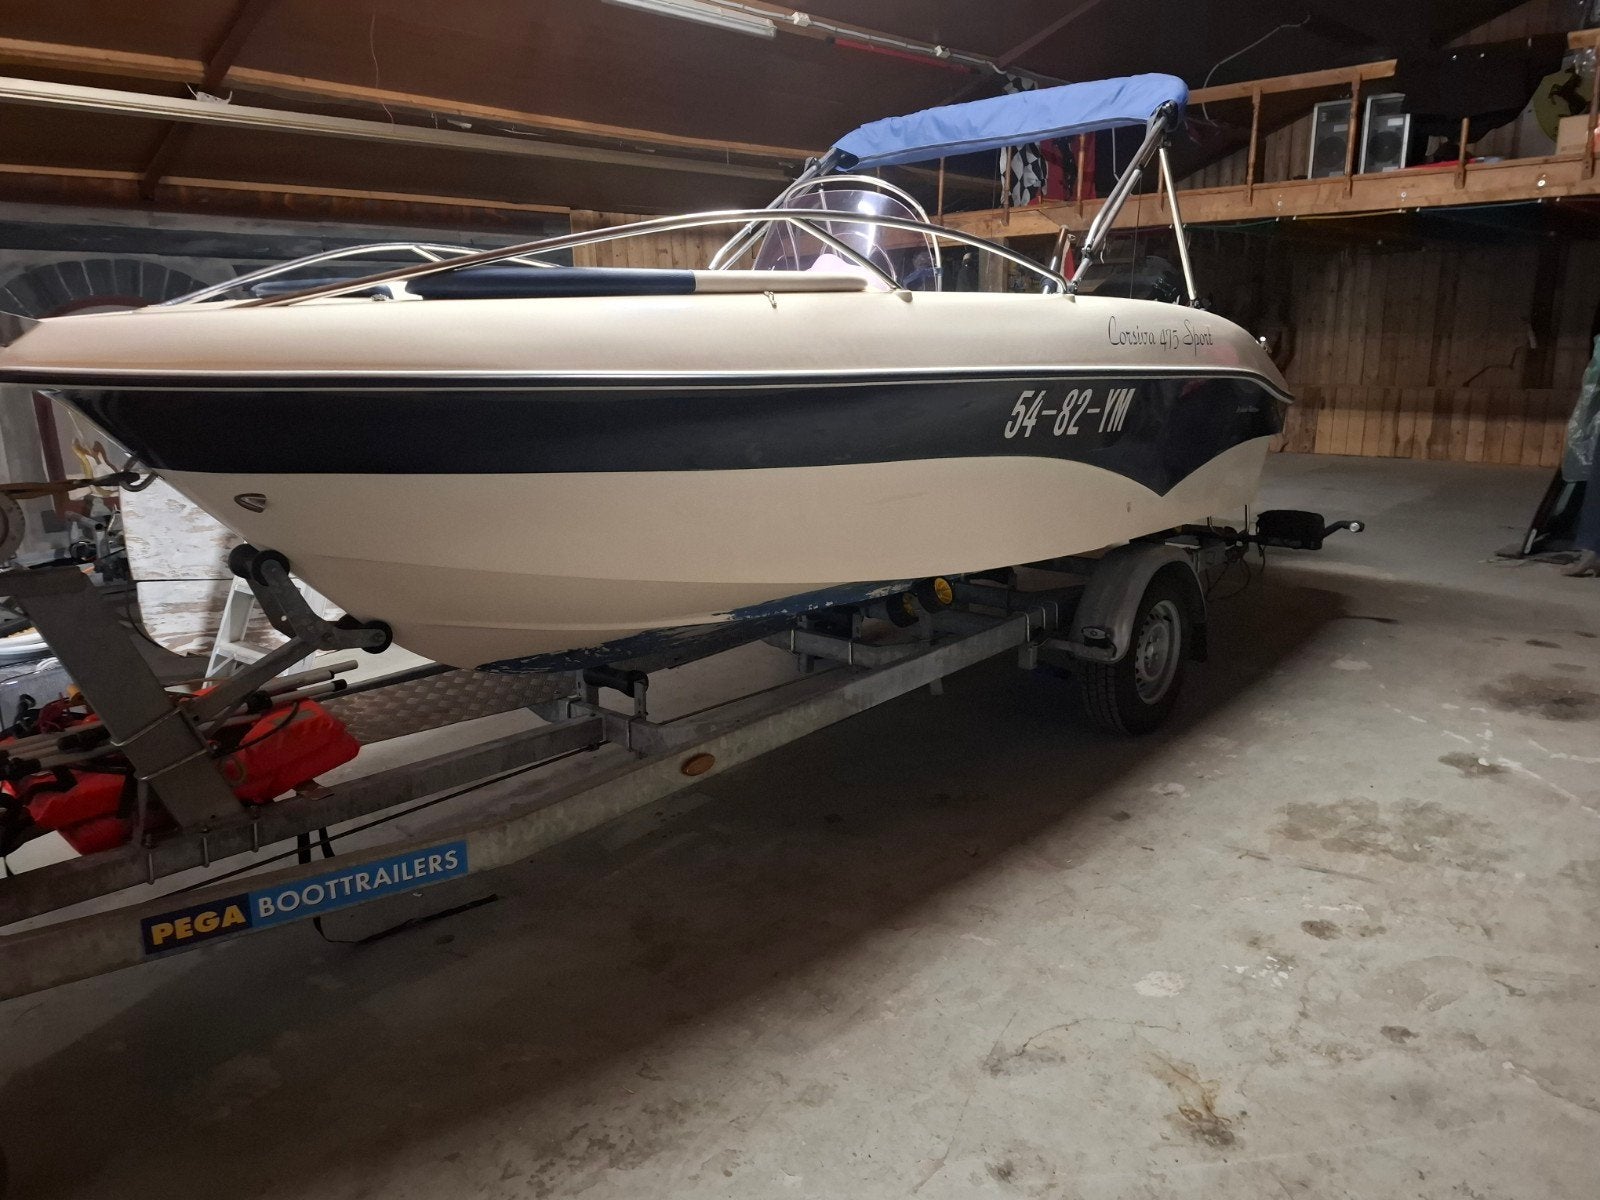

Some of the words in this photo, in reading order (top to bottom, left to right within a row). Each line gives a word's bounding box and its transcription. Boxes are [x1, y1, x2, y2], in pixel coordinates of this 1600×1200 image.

[1108, 315, 1156, 346] Corsiva
[1160, 328, 1180, 352] 475
[1183, 318, 1214, 357] Sport
[1004, 387, 1136, 439] 54-82-YM
[150, 904, 247, 946] PEGA
[257, 848, 459, 919] BOOTTRAILERS
